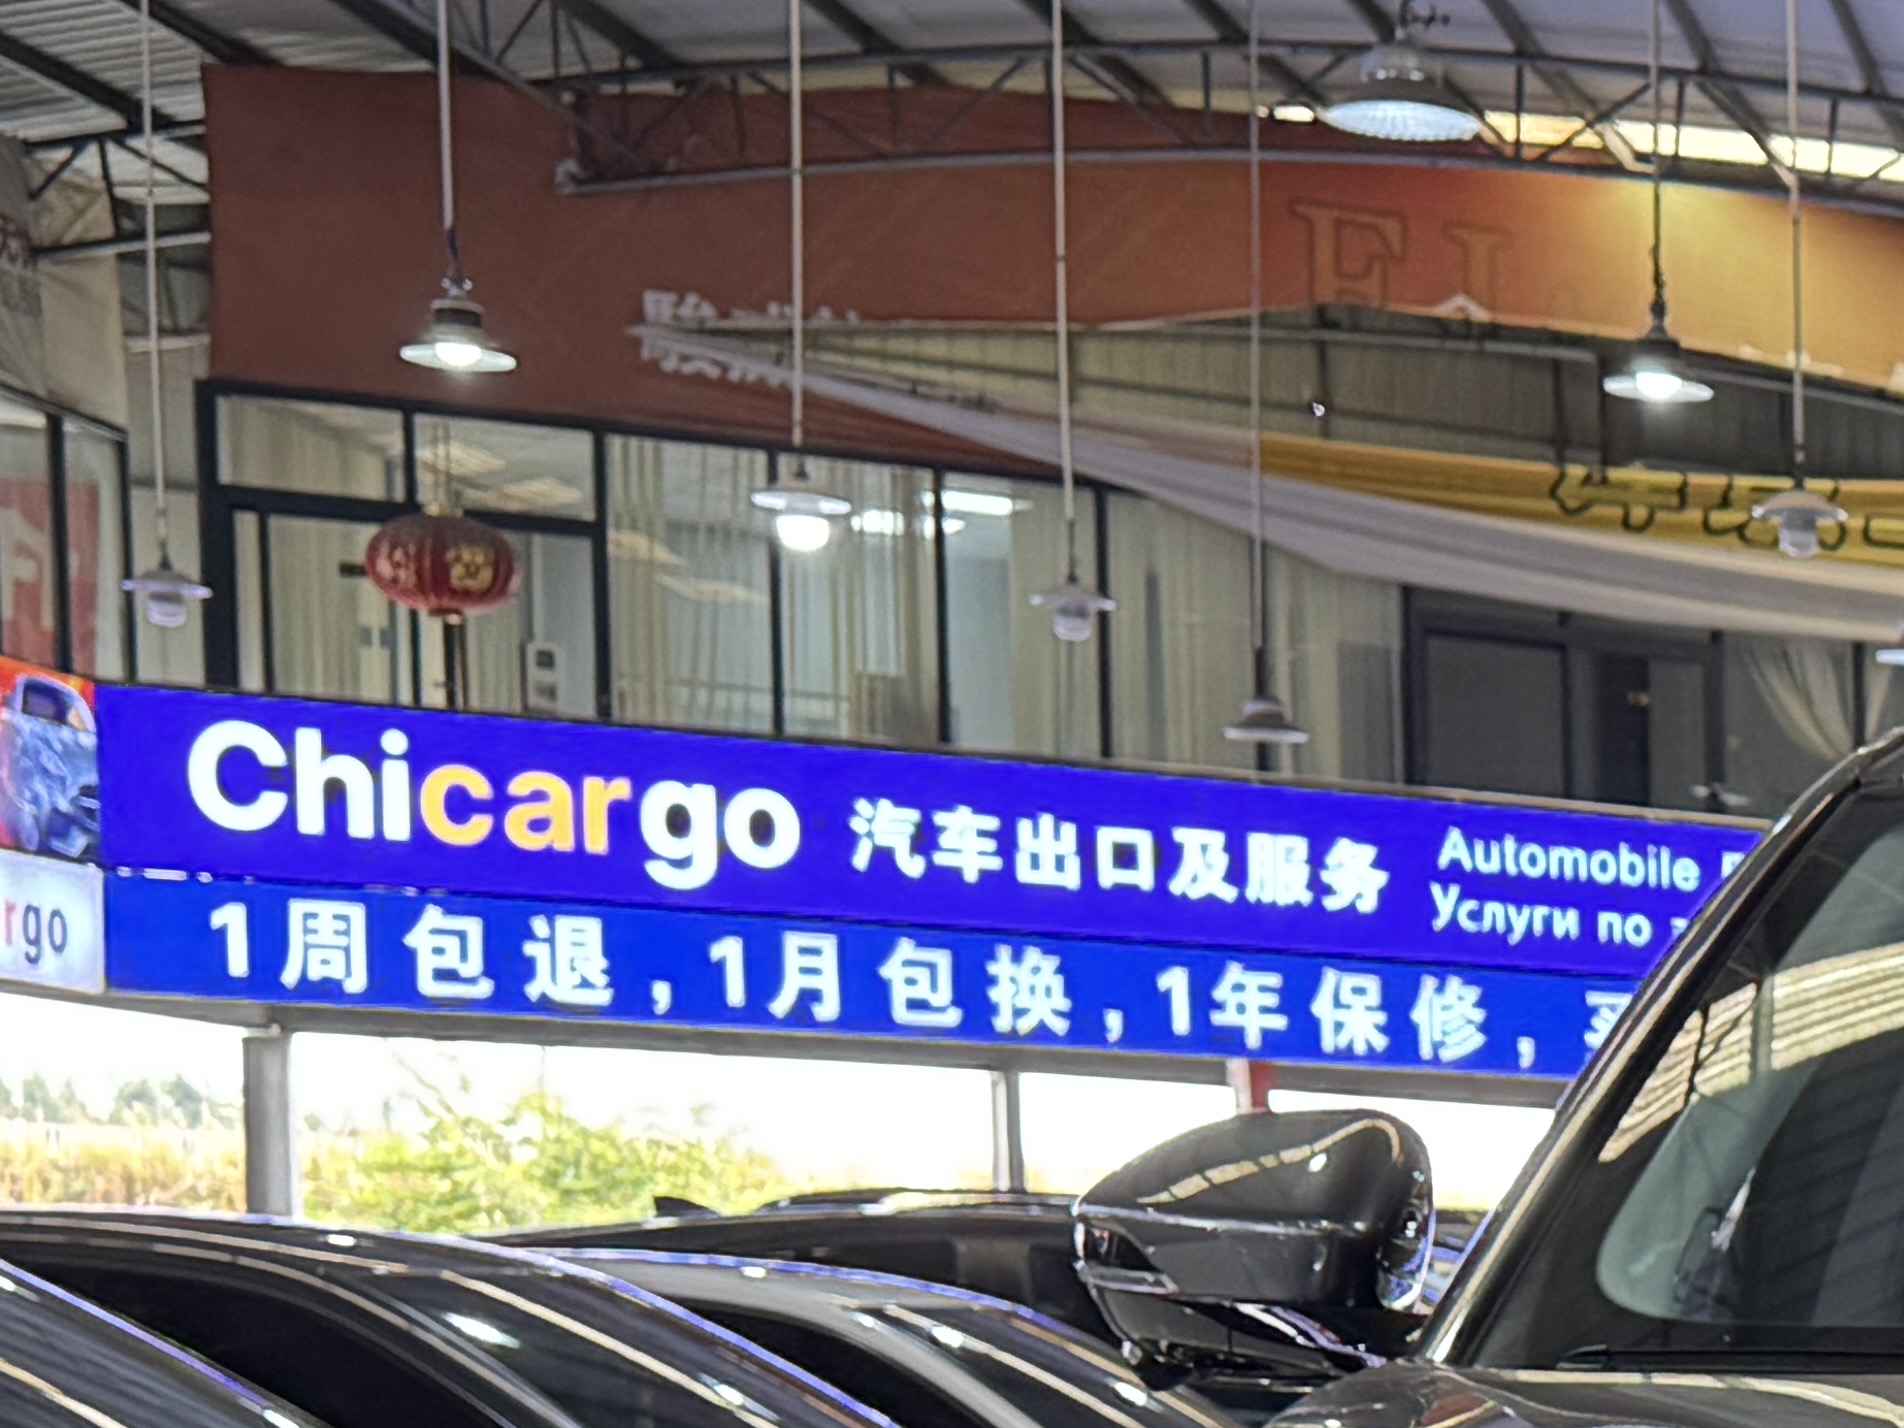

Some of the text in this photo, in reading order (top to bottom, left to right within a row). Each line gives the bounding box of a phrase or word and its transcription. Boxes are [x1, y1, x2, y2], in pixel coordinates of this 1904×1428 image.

[188, 719, 801, 890] Chicargo
[849, 797, 1389, 914] 汽车出口及服务
[1437, 826, 1701, 892] Automobile
[1429, 881, 1652, 947] Услуги по
